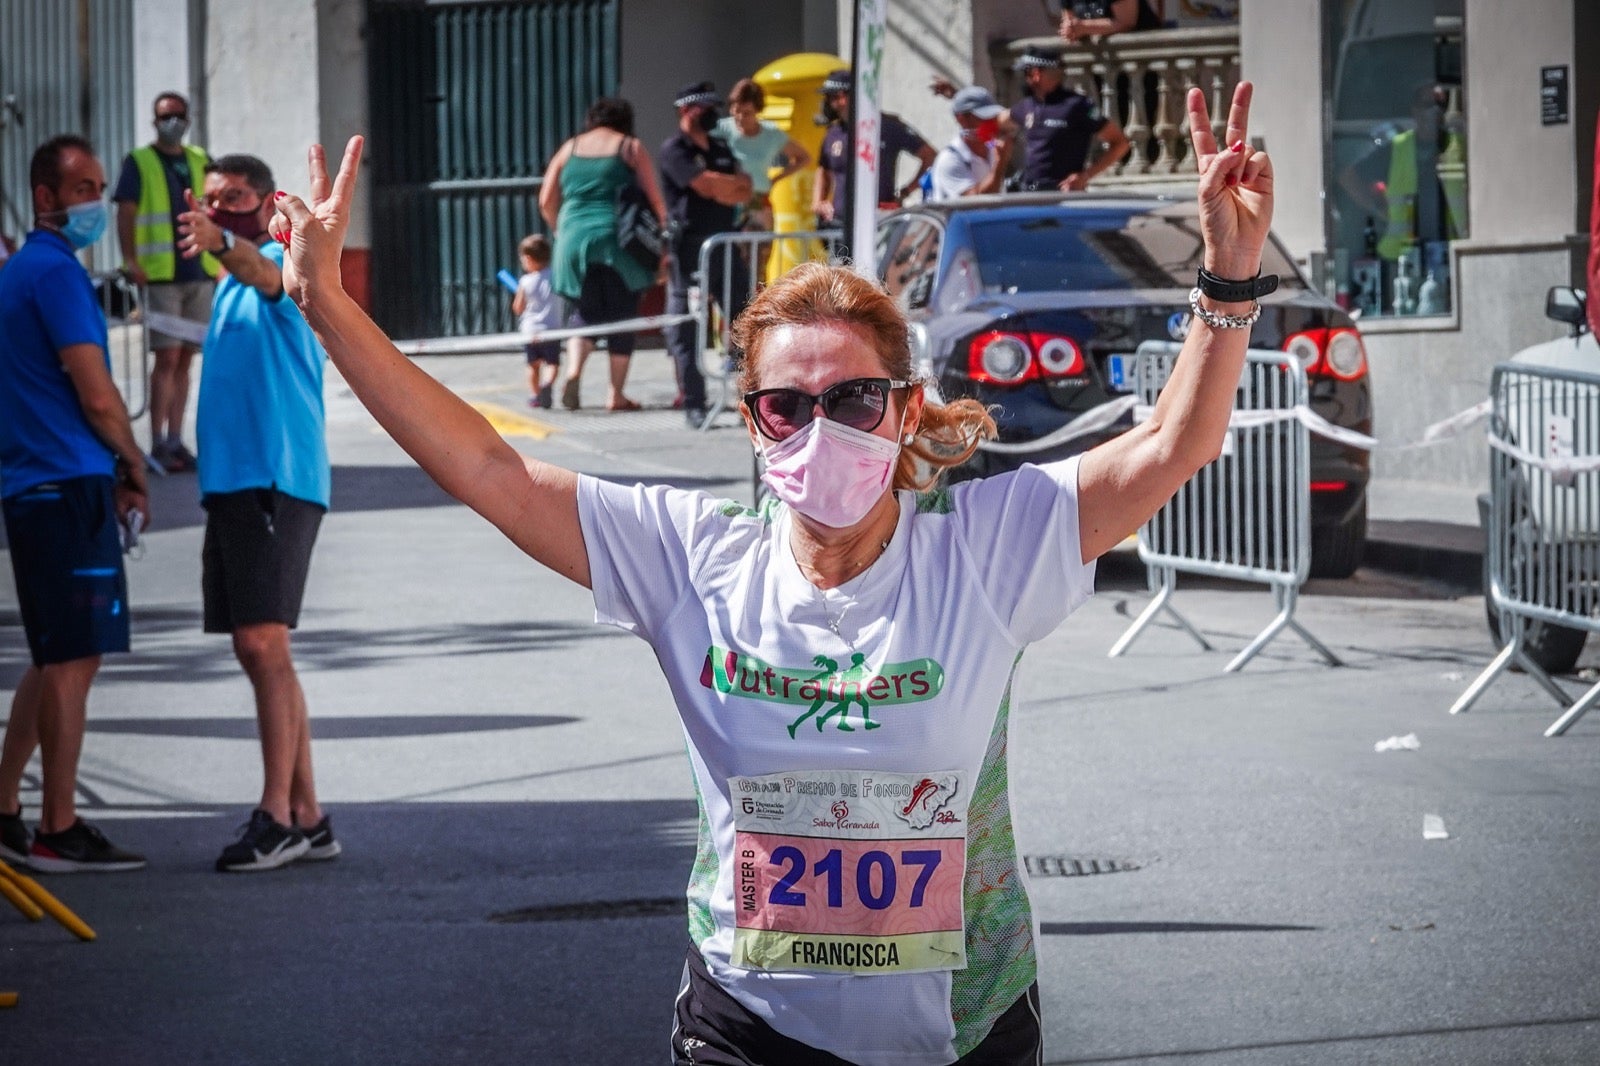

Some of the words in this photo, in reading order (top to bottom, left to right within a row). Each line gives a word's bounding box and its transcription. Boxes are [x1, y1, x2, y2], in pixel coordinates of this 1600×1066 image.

[700, 647, 930, 701] Nutrainers
[783, 777, 836, 796] PREMIO
[841, 783, 857, 797] DE
[863, 778, 911, 798] FONDO
[812, 818, 836, 828] Sabor
[841, 820, 880, 830] Granada
[741, 849, 755, 859] B
[741, 861, 756, 912] MASTER
[768, 845, 942, 911] 2107
[792, 941, 900, 966] FRANCISCA
